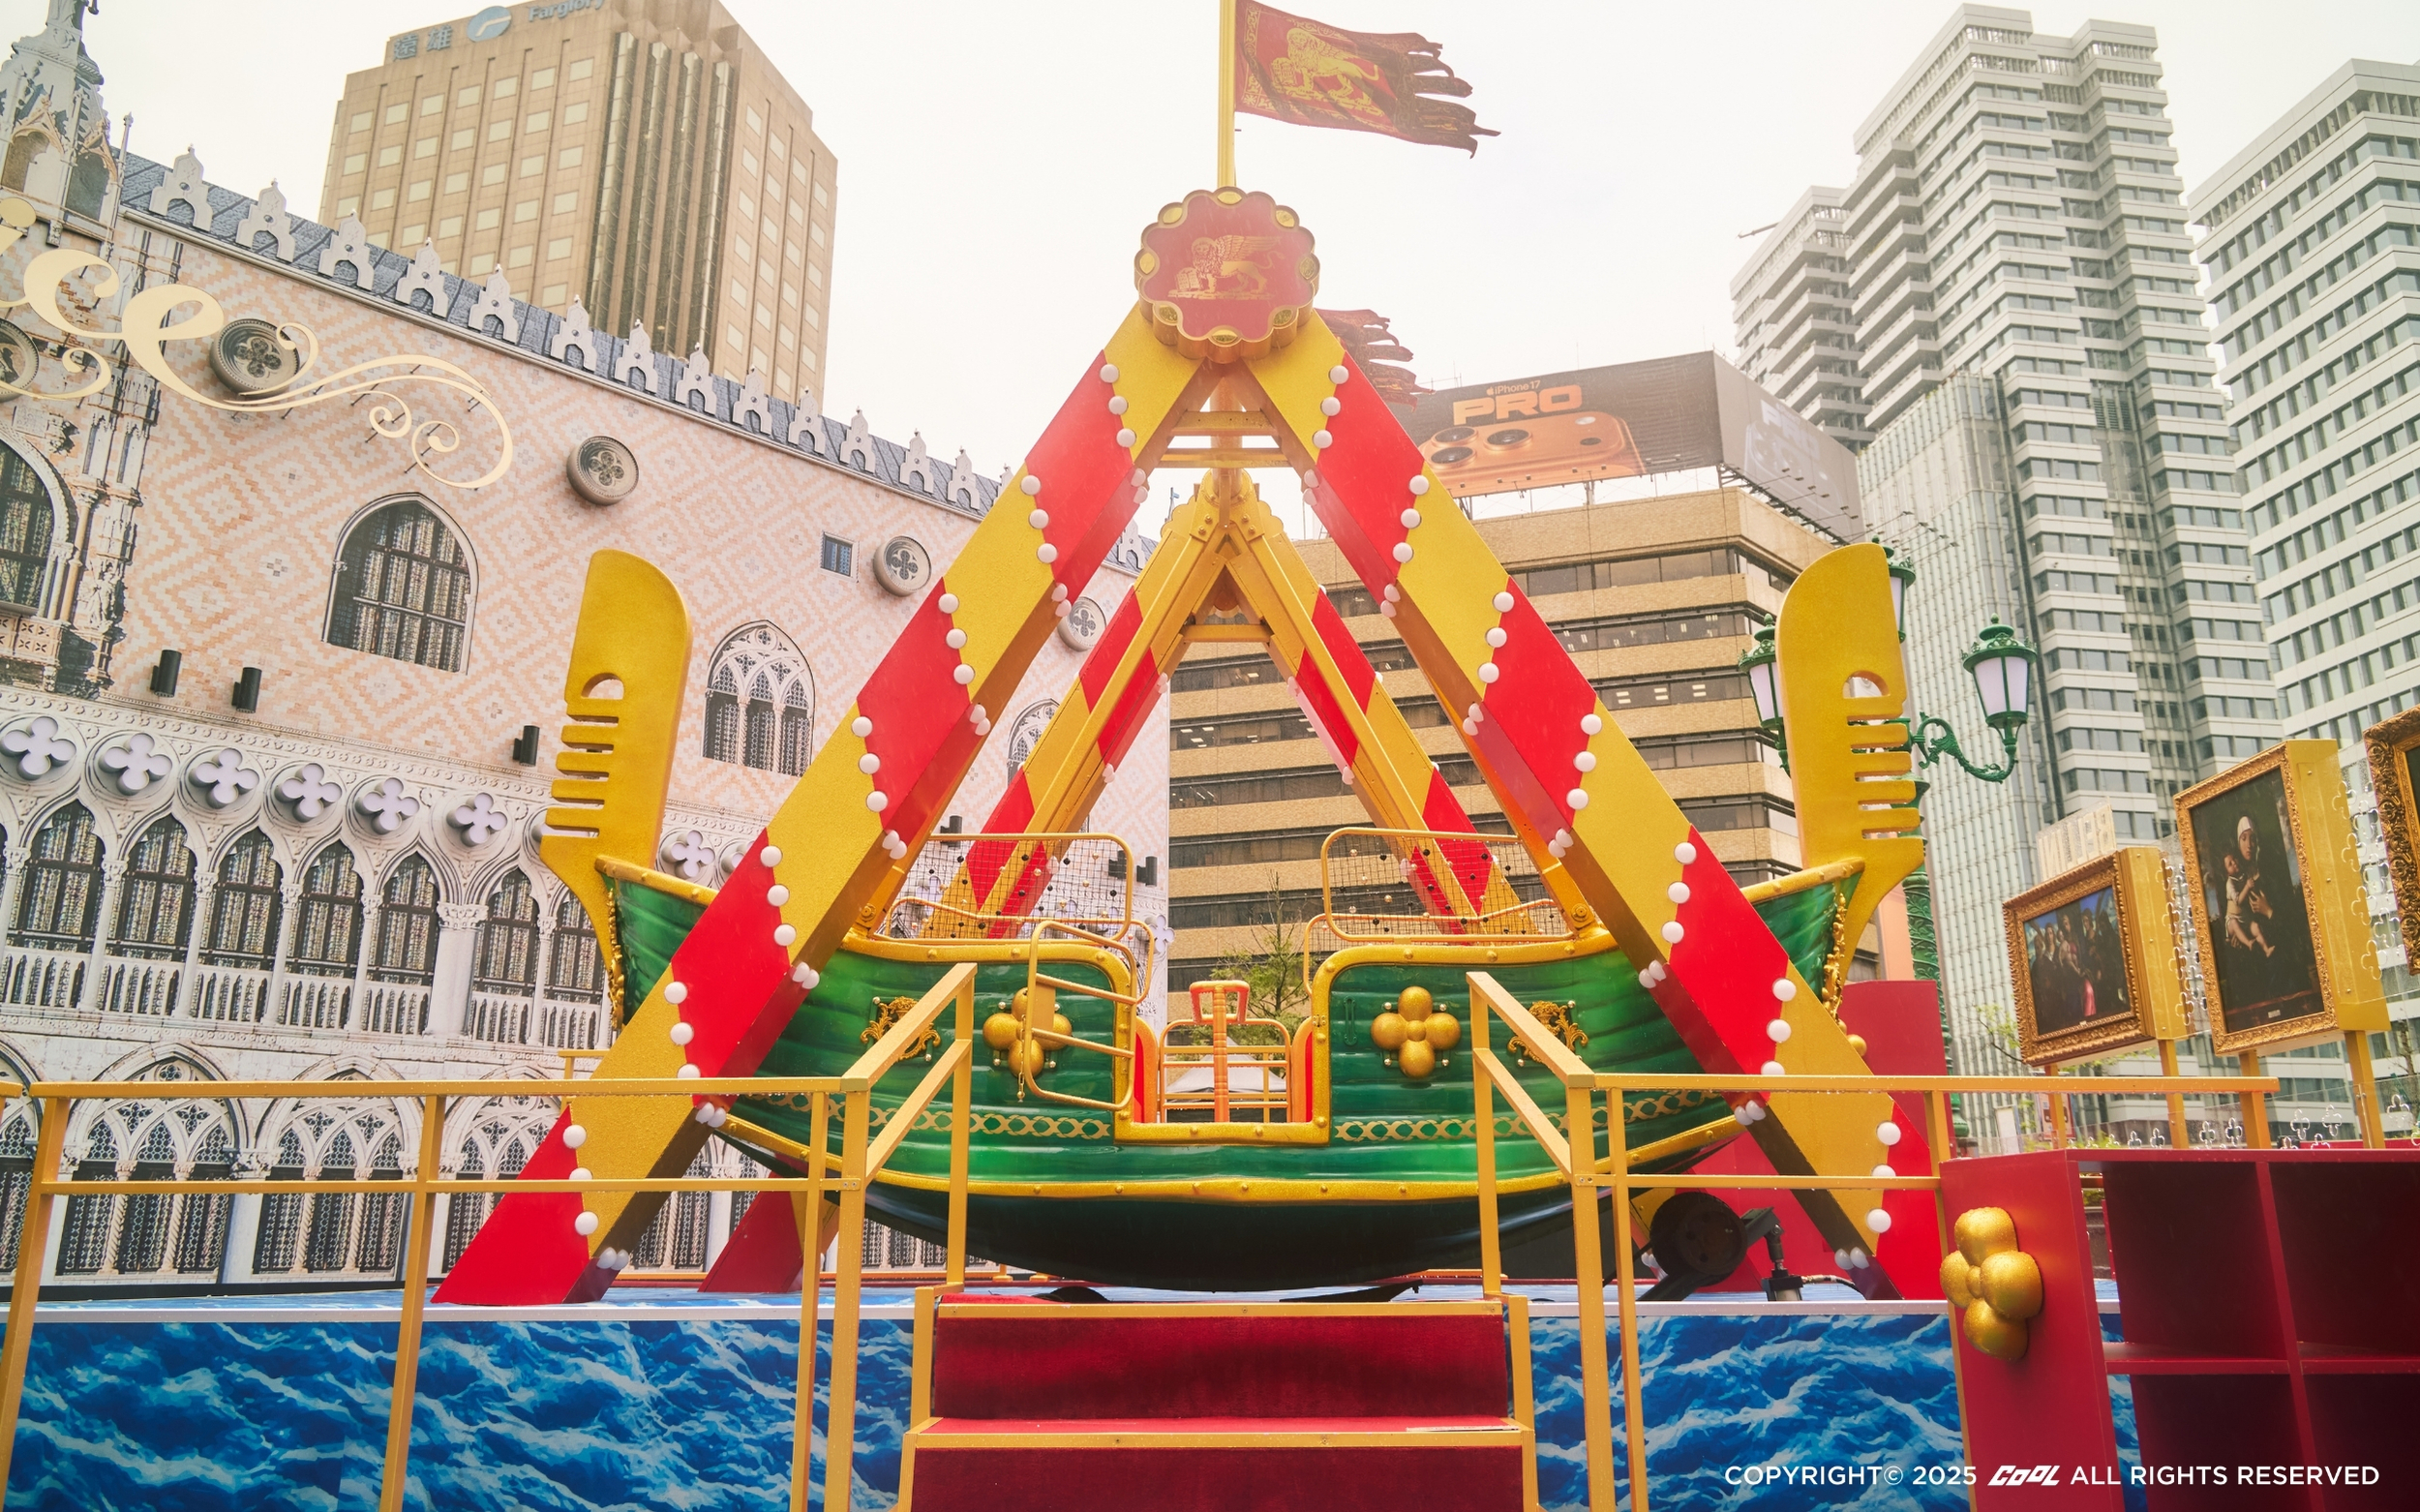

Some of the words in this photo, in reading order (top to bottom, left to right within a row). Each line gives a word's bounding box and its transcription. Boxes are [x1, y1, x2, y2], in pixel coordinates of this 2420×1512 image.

[393, 25, 453, 61] 遠雄
[1453, 384, 1583, 426] PRO
[1495, 382, 1529, 395] iPhone
[1529, 379, 1541, 390] 17
